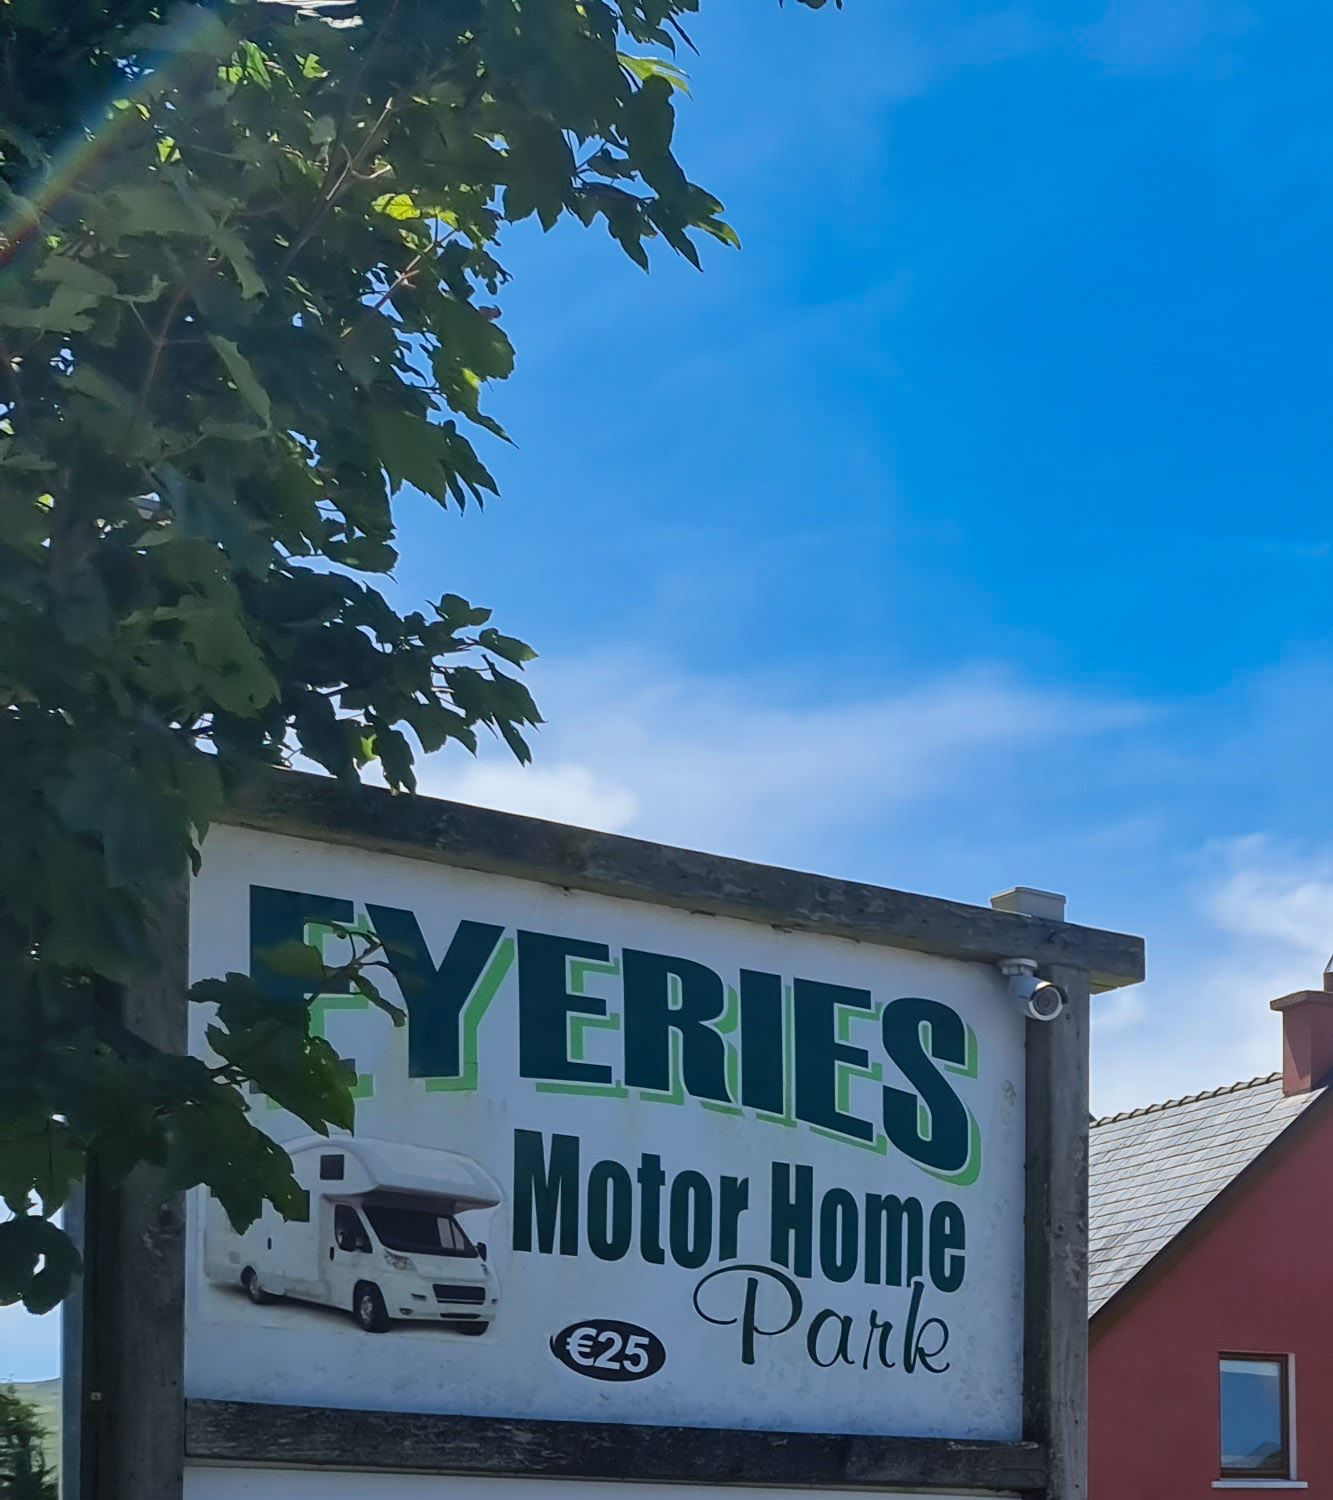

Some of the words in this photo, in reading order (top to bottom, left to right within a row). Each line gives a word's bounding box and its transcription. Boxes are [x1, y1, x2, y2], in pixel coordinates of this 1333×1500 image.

[249, 884, 979, 1186] EYERIES
[512, 1128, 750, 1269] Motor
[770, 1161, 967, 1293] Home
[565, 1326, 650, 1374] €25
[693, 1264, 951, 1374] Park
